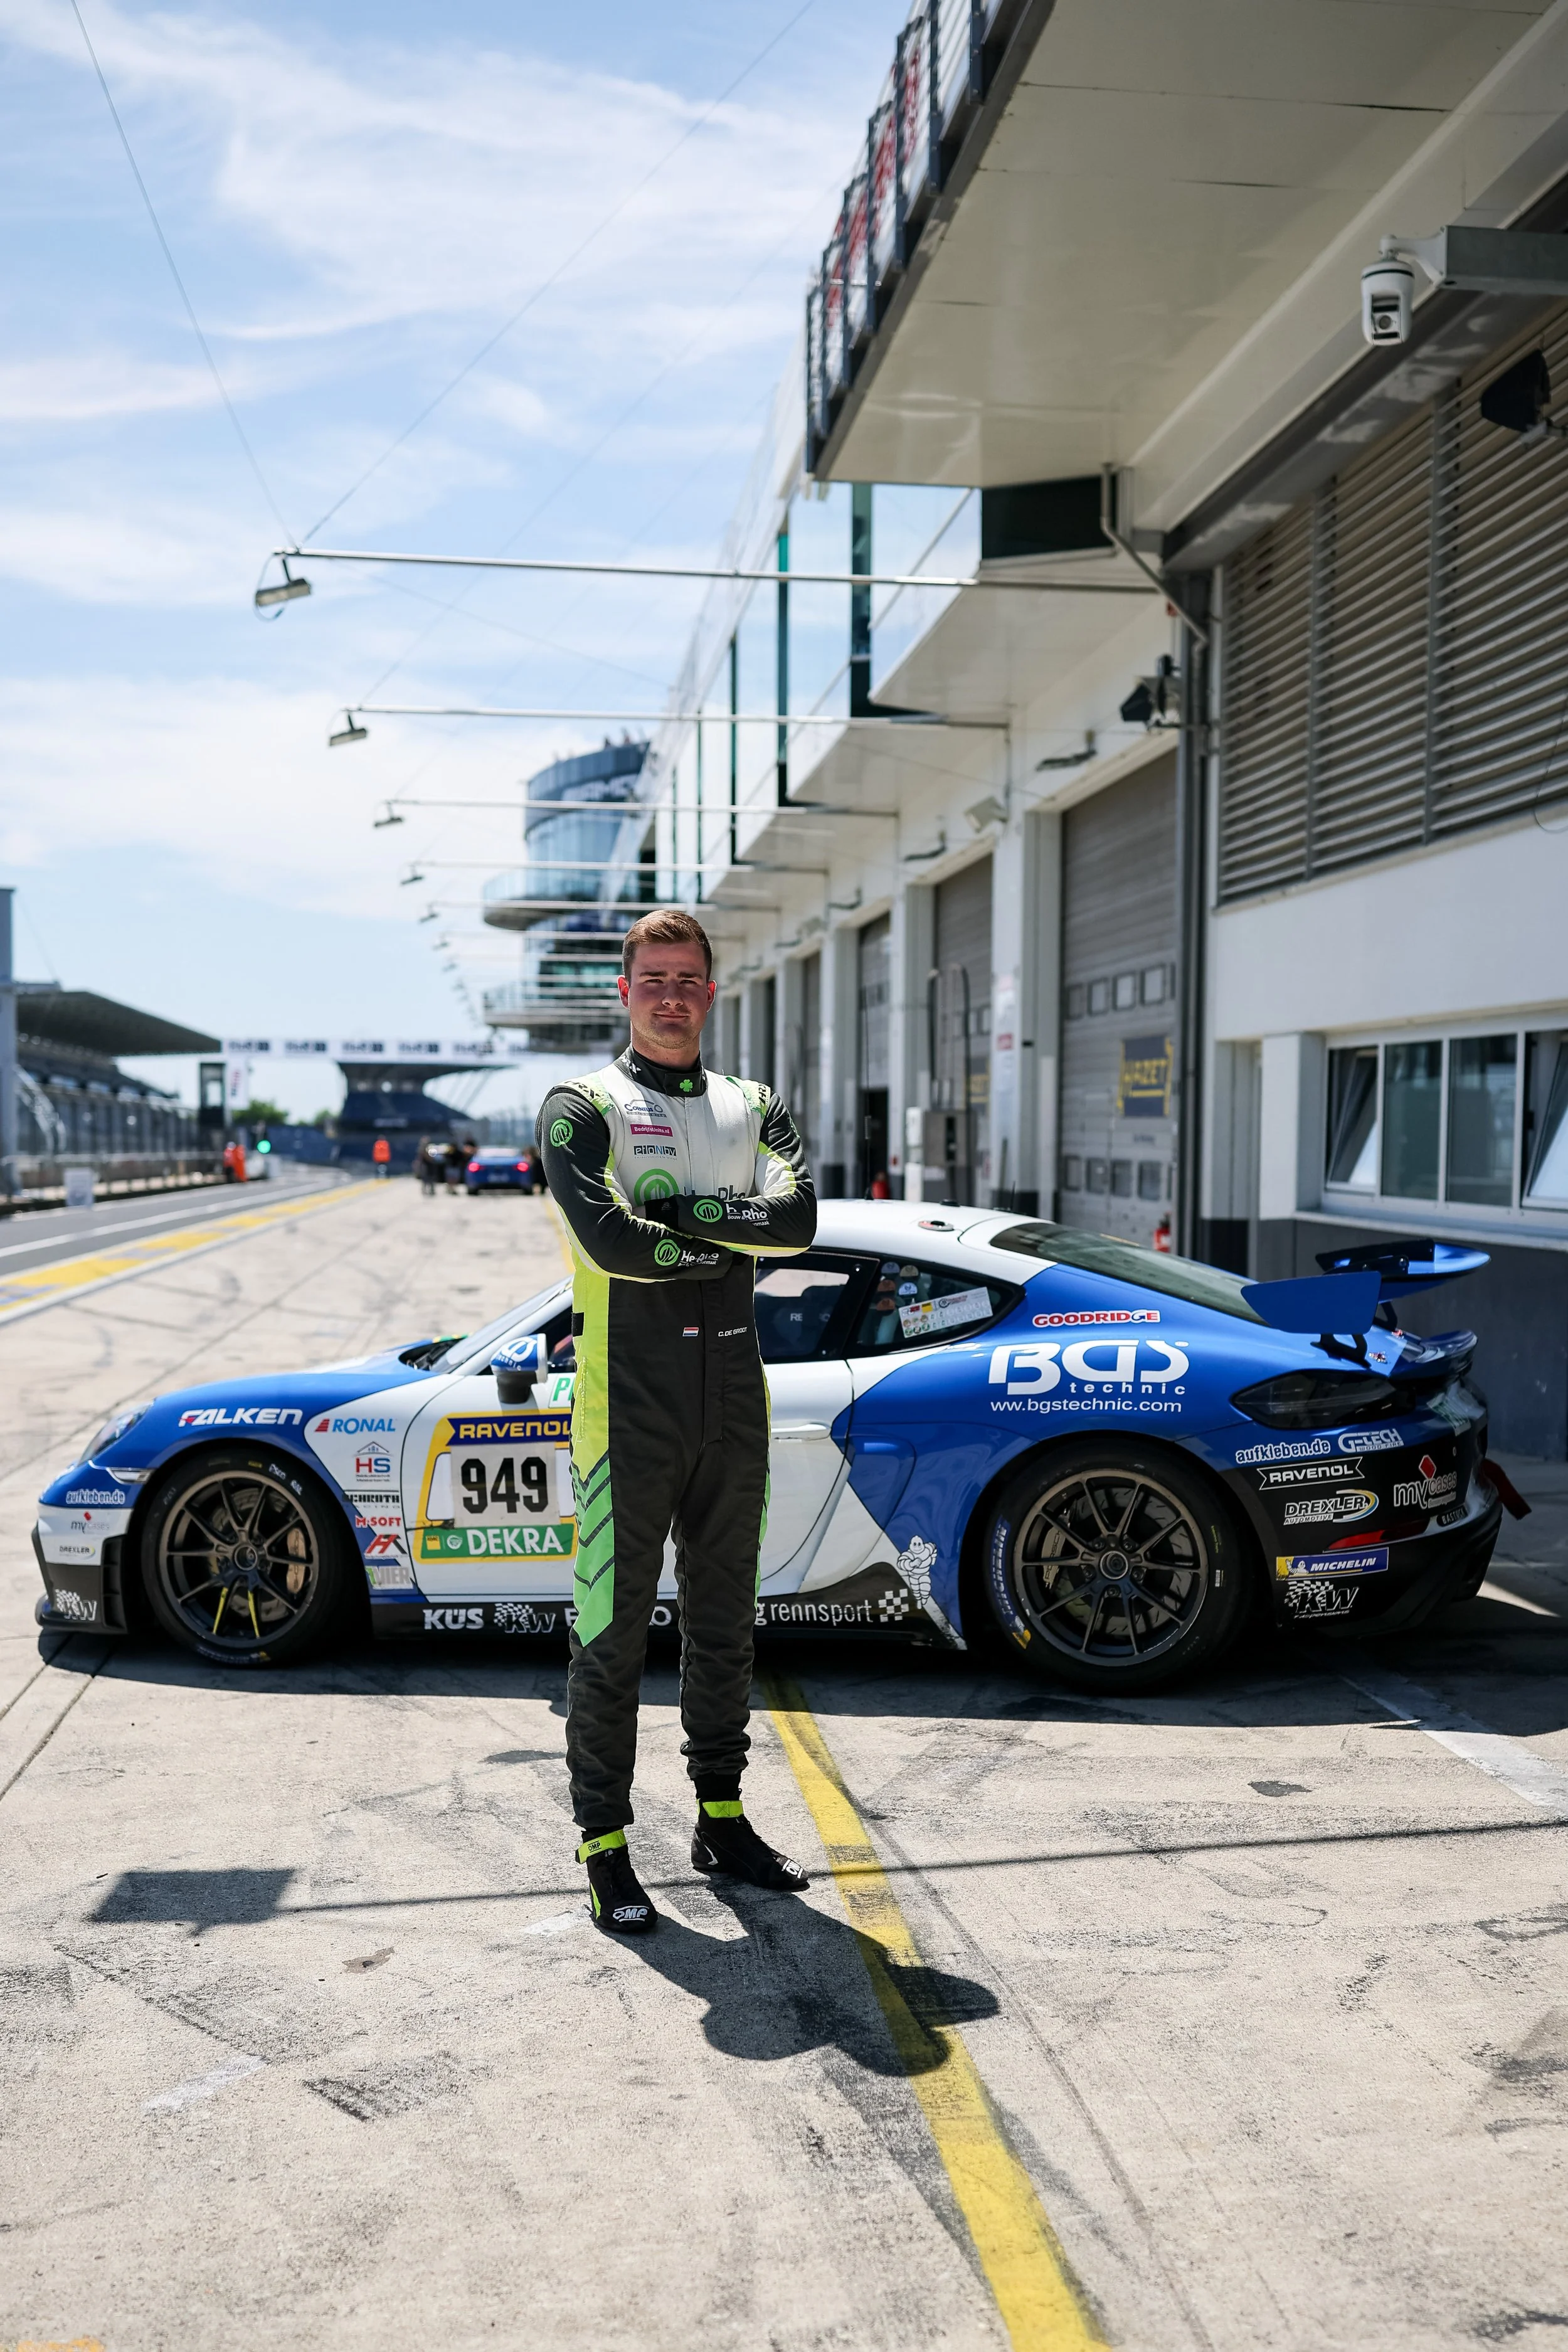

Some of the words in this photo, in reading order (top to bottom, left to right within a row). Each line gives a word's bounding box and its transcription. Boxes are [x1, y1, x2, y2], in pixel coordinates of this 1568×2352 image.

[1034, 1310, 1159, 1327] GOODRIDGE
[733, 1327, 747, 1335] GROOT
[988, 1339, 1190, 1395] BGS
[1069, 1382, 1186, 1395] technic
[179, 1407, 303, 1427] FALKEN
[332, 1418, 396, 1434] RONAL
[459, 1421, 569, 1439] RAVENOL
[1236, 1439, 1331, 1464] aufkleben.de
[356, 1458, 391, 1473] HS
[1269, 1465, 1353, 1483] RAVENOL
[461, 1456, 549, 1514] 949
[66, 1489, 125, 1505] aufkleben.de
[1285, 1496, 1362, 1518] DREXLER
[466, 1527, 564, 1555] DEKRA
[1310, 1557, 1377, 1572] MICHELIN
[422, 1608, 484, 1629] KÜS
[770, 1600, 873, 1626] rennsport
[588, 1842, 600, 1851] OMP
[612, 1908, 648, 1920] OMP
